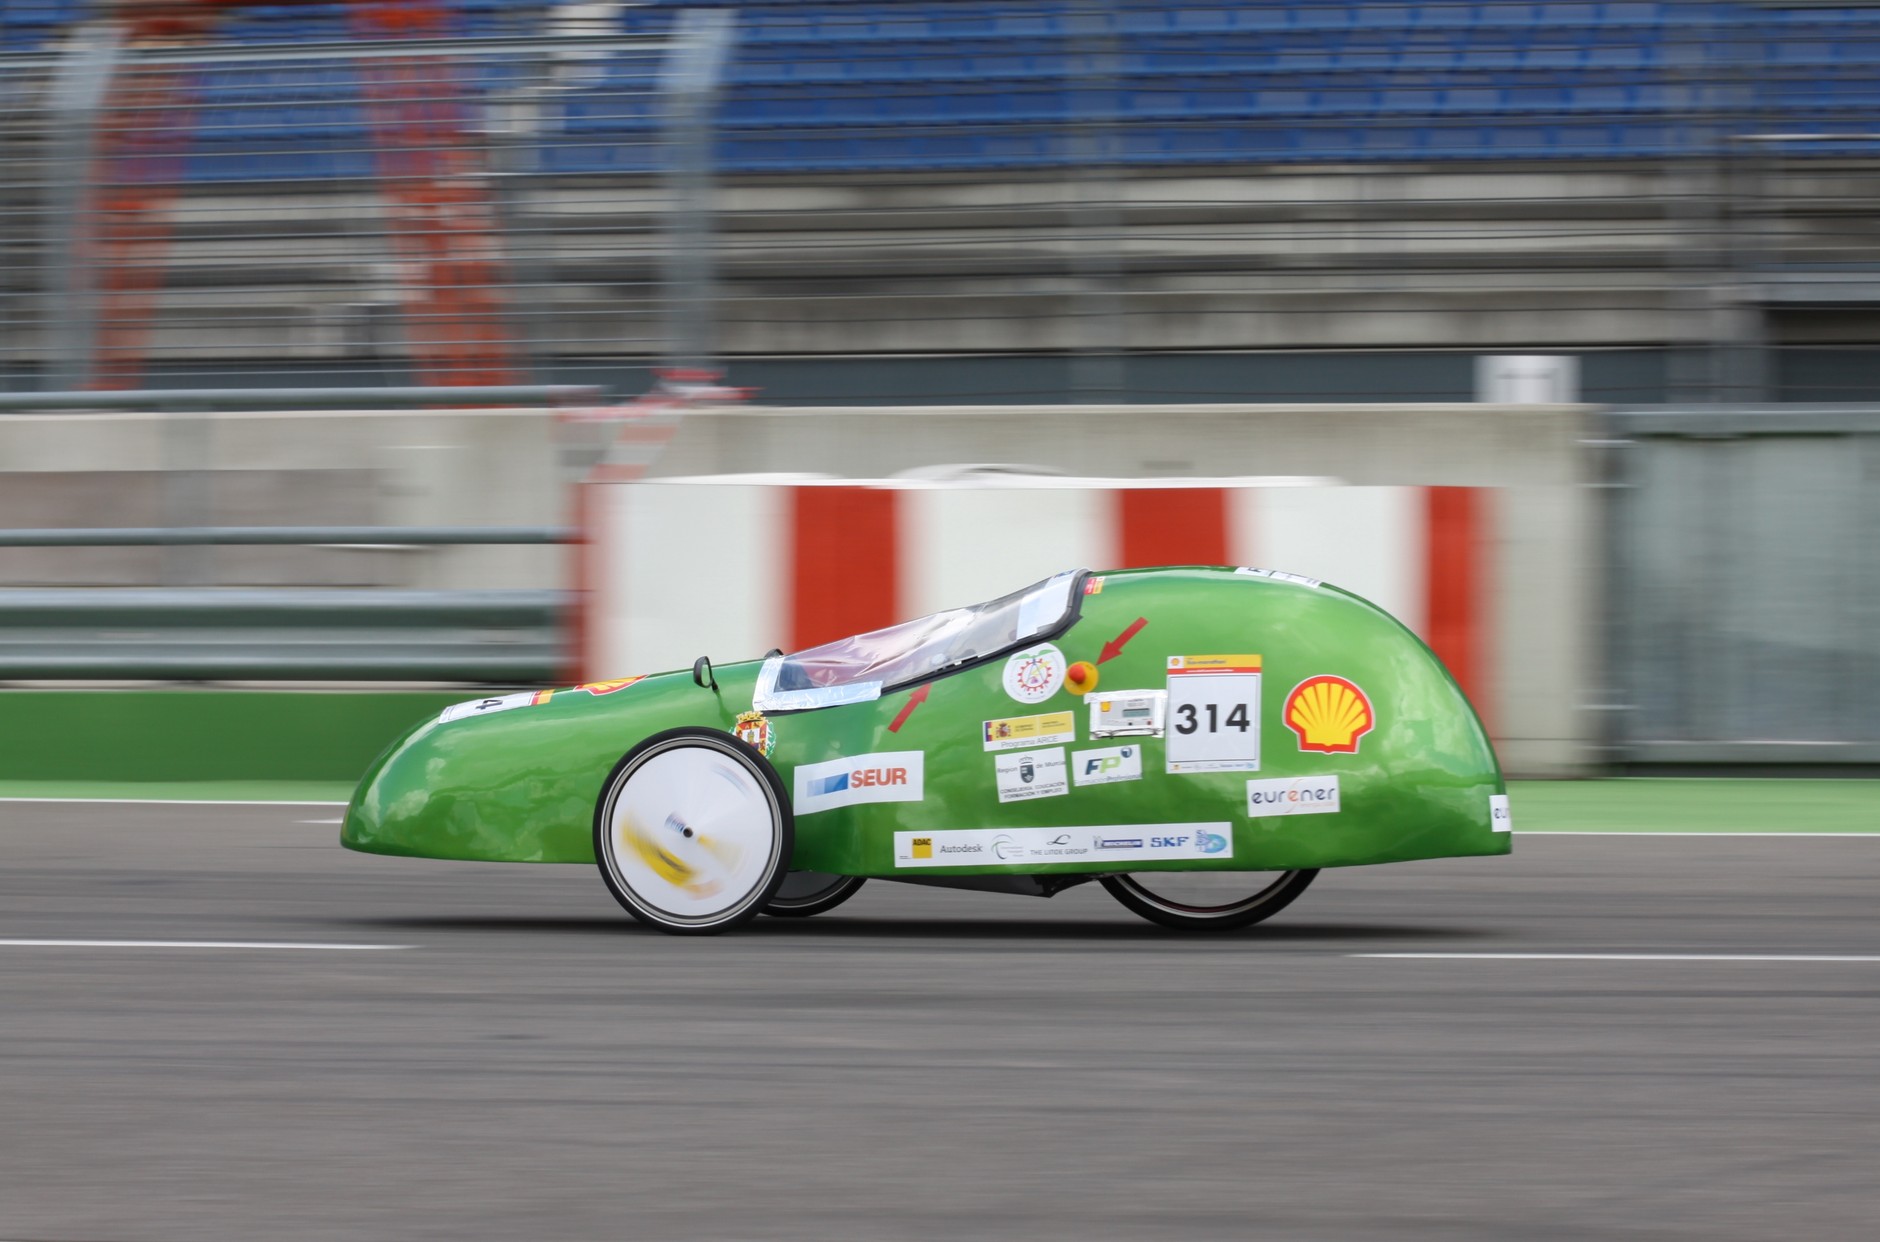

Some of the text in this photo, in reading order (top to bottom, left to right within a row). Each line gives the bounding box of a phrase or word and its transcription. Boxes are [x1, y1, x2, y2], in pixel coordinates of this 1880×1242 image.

[1175, 703, 1250, 735] 314
[1036, 735, 1058, 744] ARCE
[1084, 755, 1121, 775] FP
[850, 767, 907, 789] SEUR
[1251, 787, 1336, 805] eurener
[912, 838, 984, 854] ADAC Autodesk
[1065, 847, 1089, 855] GROUP
[1150, 837, 1189, 848] SKF
